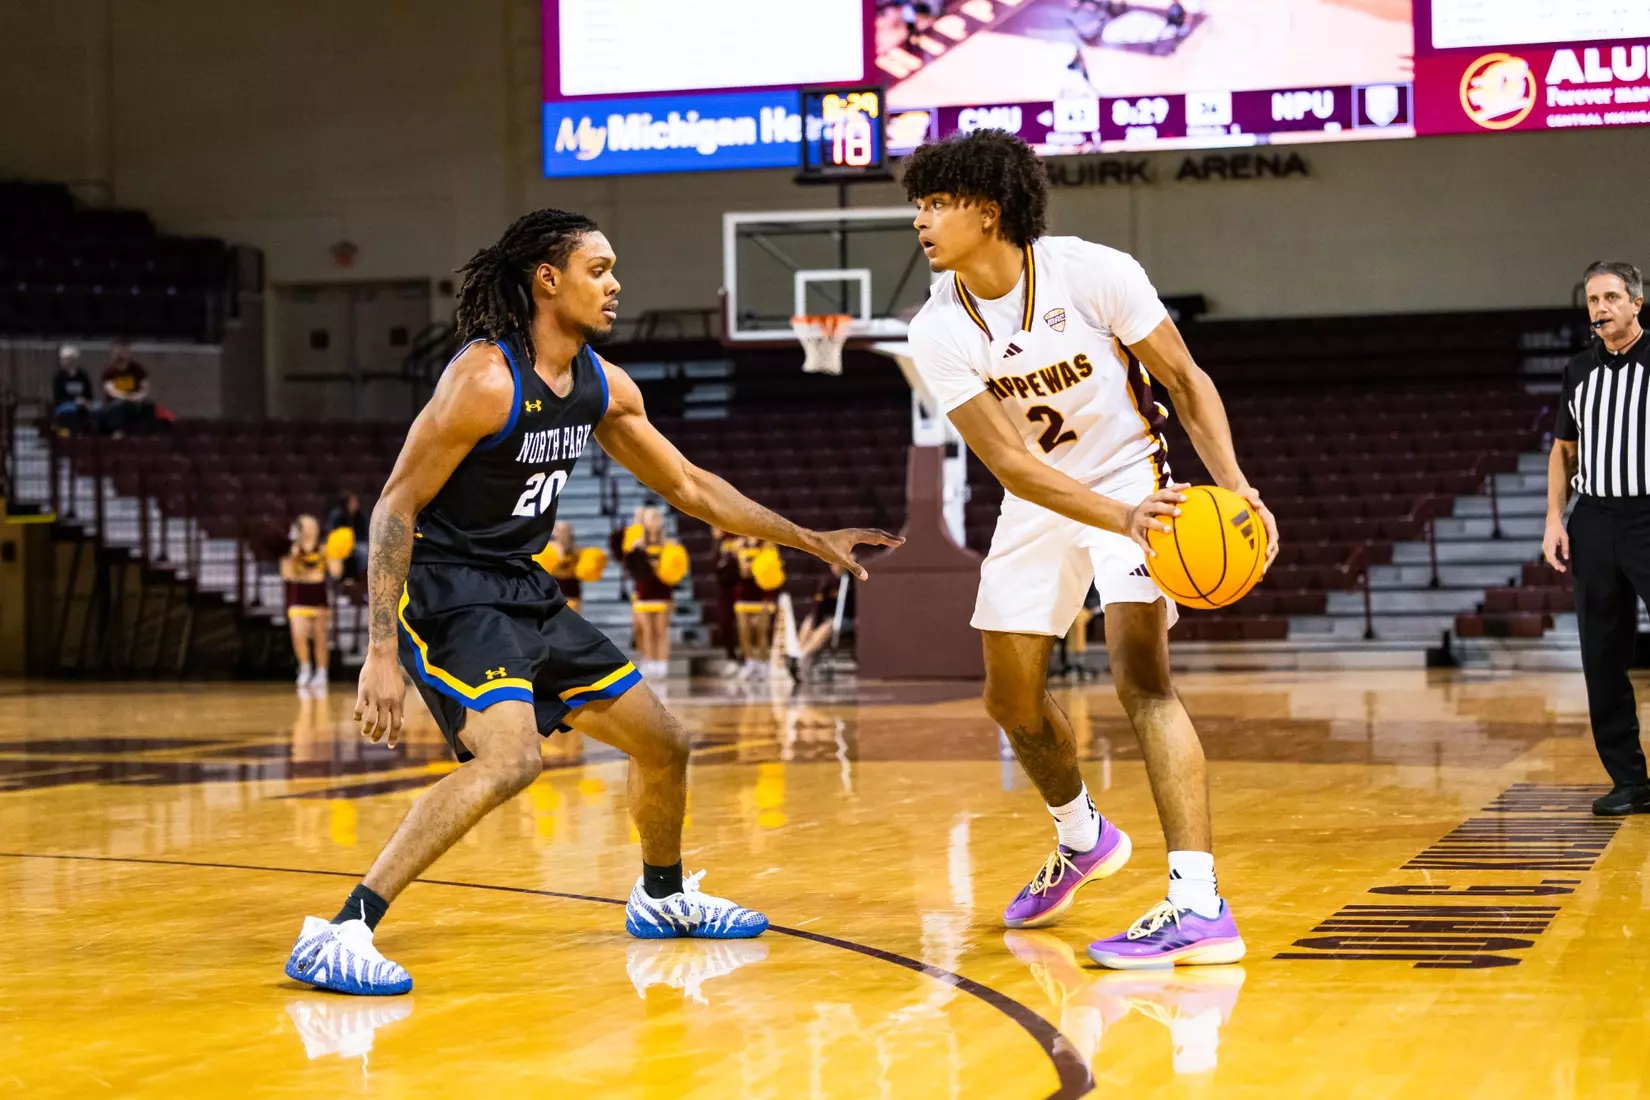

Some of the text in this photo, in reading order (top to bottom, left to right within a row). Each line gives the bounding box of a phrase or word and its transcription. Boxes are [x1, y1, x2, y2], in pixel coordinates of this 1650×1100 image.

[1545, 45, 1650, 85] ALU
[957, 105, 1023, 136] CMU
[1271, 90, 1334, 121] NPU
[555, 116, 607, 161] My
[606, 110, 757, 156] Michigan
[1174, 151, 1311, 182] ARENA
[985, 353, 1094, 402] IPPEWAS
[515, 424, 592, 464] NORTH PARK
[1026, 405, 1078, 454] 2
[511, 469, 569, 517] 20
